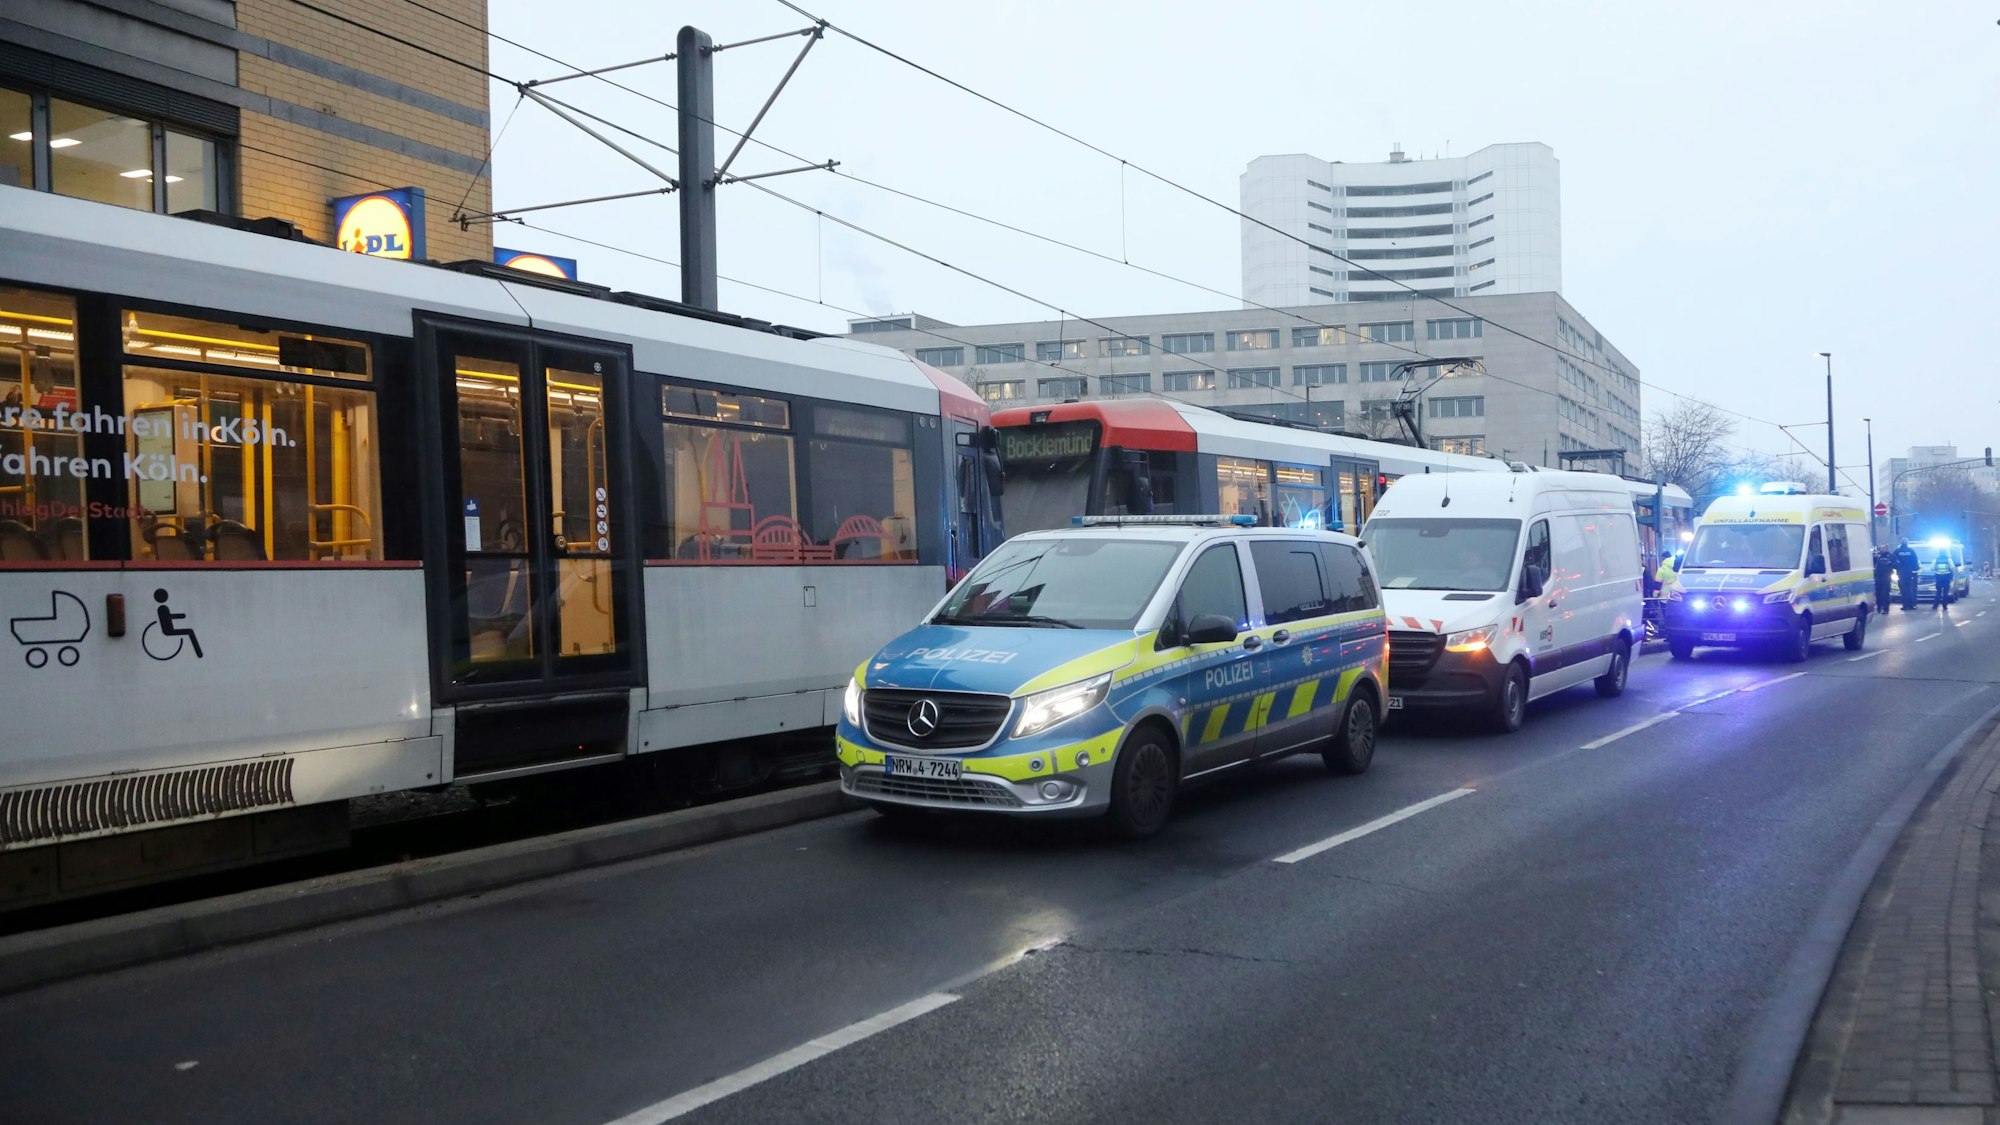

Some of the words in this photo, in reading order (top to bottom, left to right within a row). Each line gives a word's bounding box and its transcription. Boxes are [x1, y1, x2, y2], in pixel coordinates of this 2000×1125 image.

[0, 406, 42, 429] re
[53, 402, 171, 438] fahren
[180, 412, 209, 441] in
[220, 416, 297, 448] Köln.
[1006, 429, 1094, 460] Bocklemünd
[0, 444, 111, 479] ahren
[122, 451, 208, 483] Köln.
[0, 498, 146, 520] hlagDerStadt
[905, 647, 1019, 664] POLIZEI
[1205, 660, 1254, 690] POLIZEI
[892, 758, 913, 774] NRW
[918, 763, 959, 778] 4-7244
